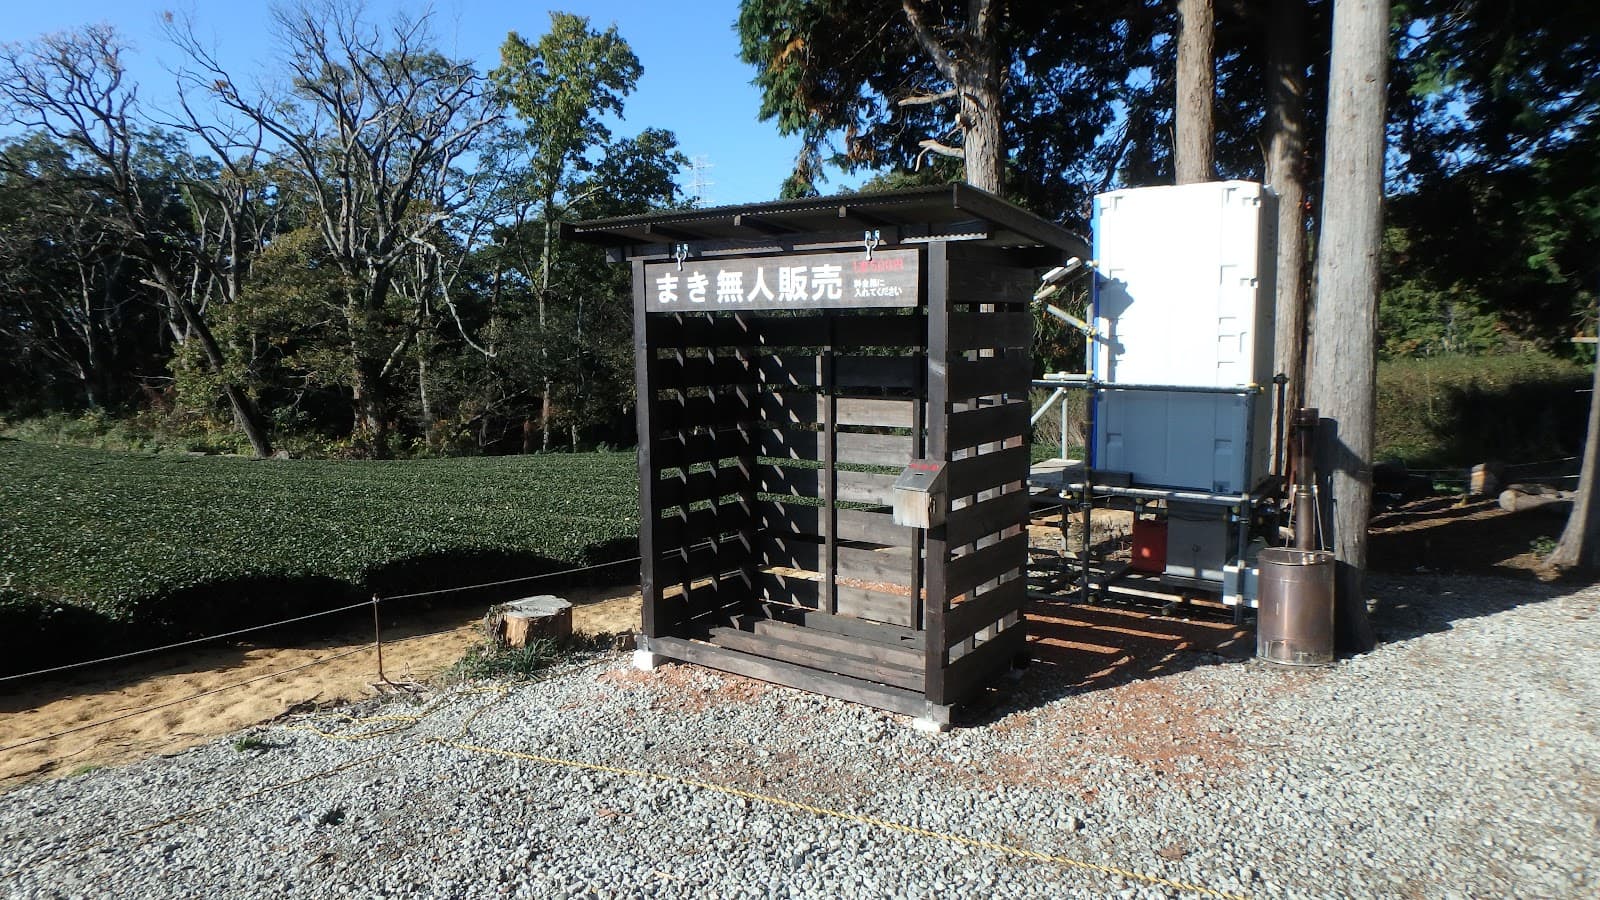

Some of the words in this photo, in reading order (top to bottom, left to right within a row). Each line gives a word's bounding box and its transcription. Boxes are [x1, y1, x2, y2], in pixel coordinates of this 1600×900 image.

[656, 263, 842, 304] まき無人販売
[854, 286, 903, 298] 入れてください
